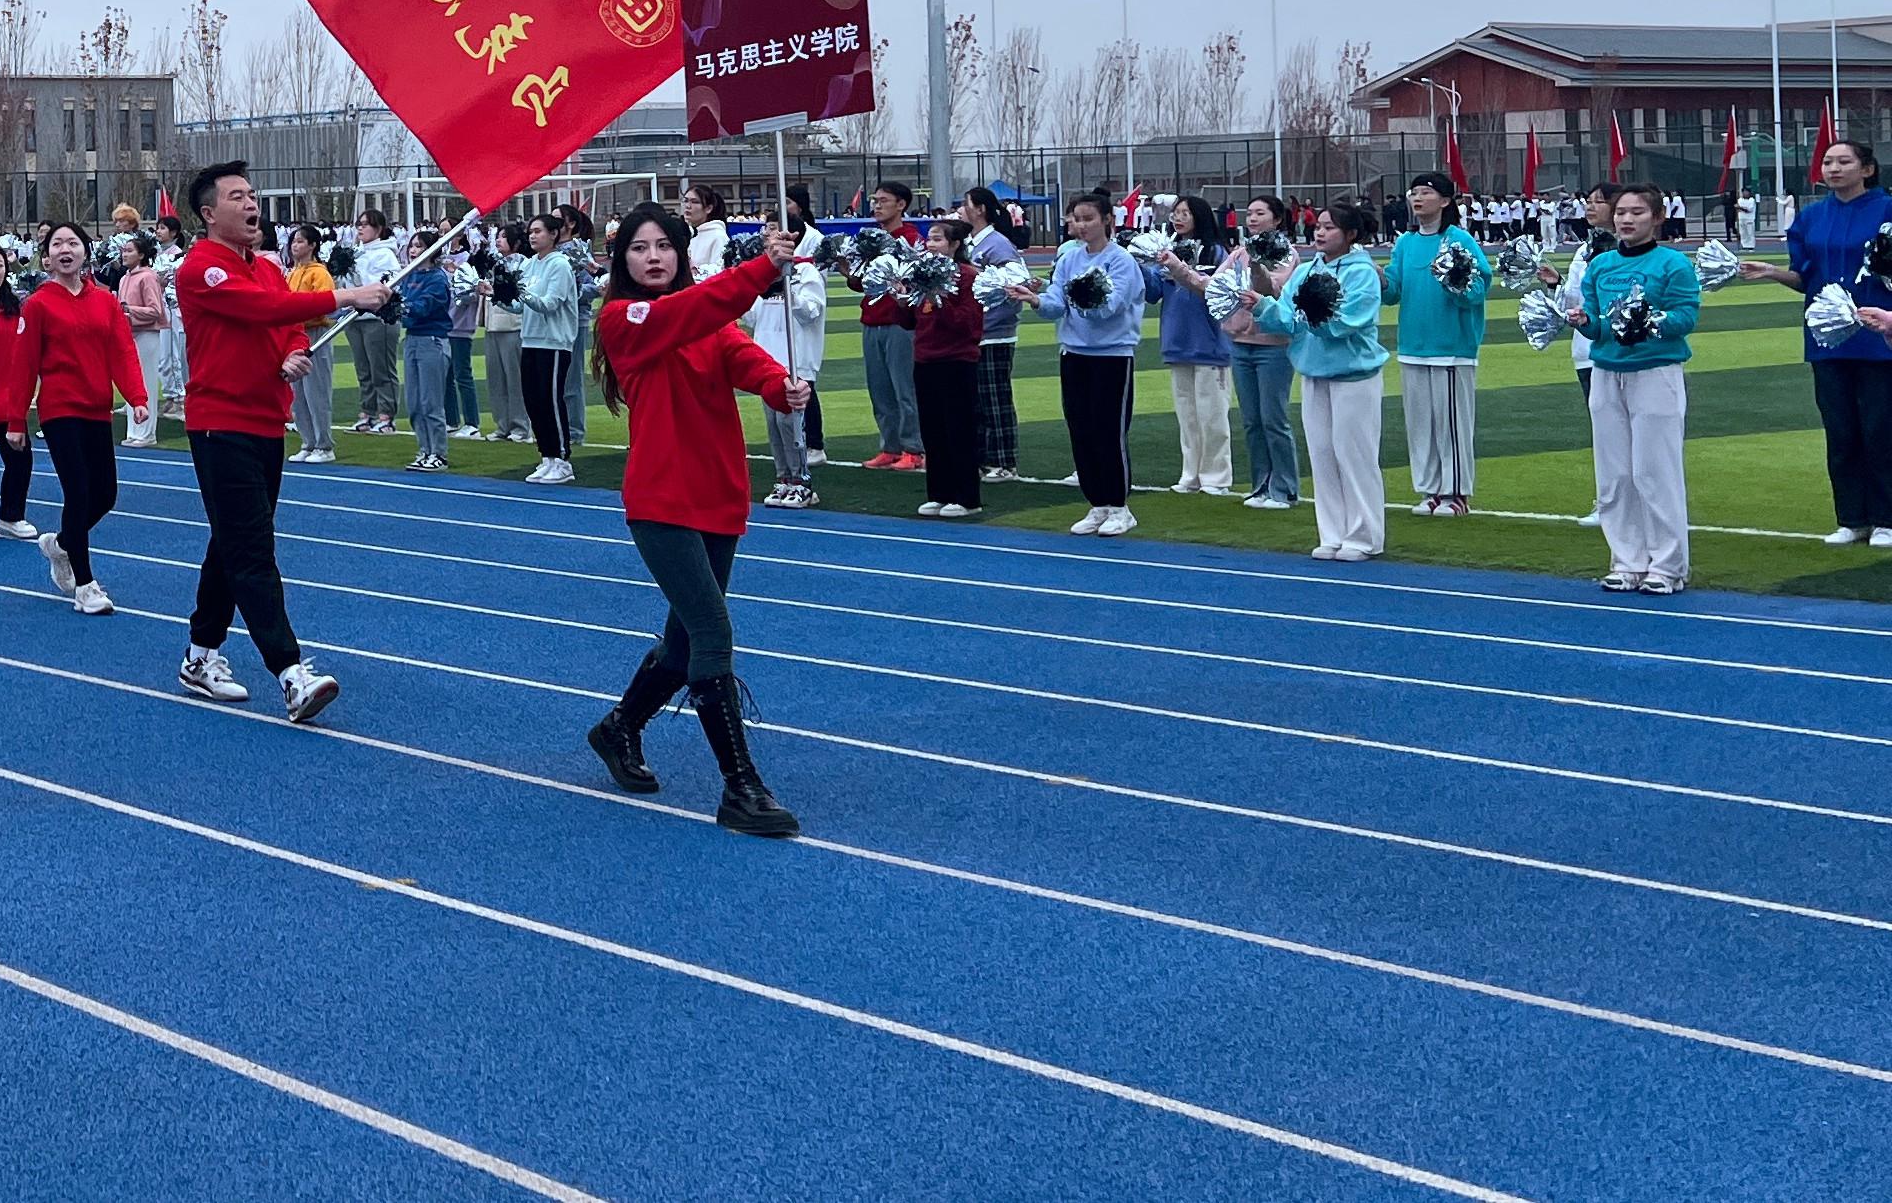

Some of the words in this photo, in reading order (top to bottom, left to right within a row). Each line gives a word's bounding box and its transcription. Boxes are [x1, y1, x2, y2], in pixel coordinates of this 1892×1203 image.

[694, 22, 860, 79] 马克思主义学院
